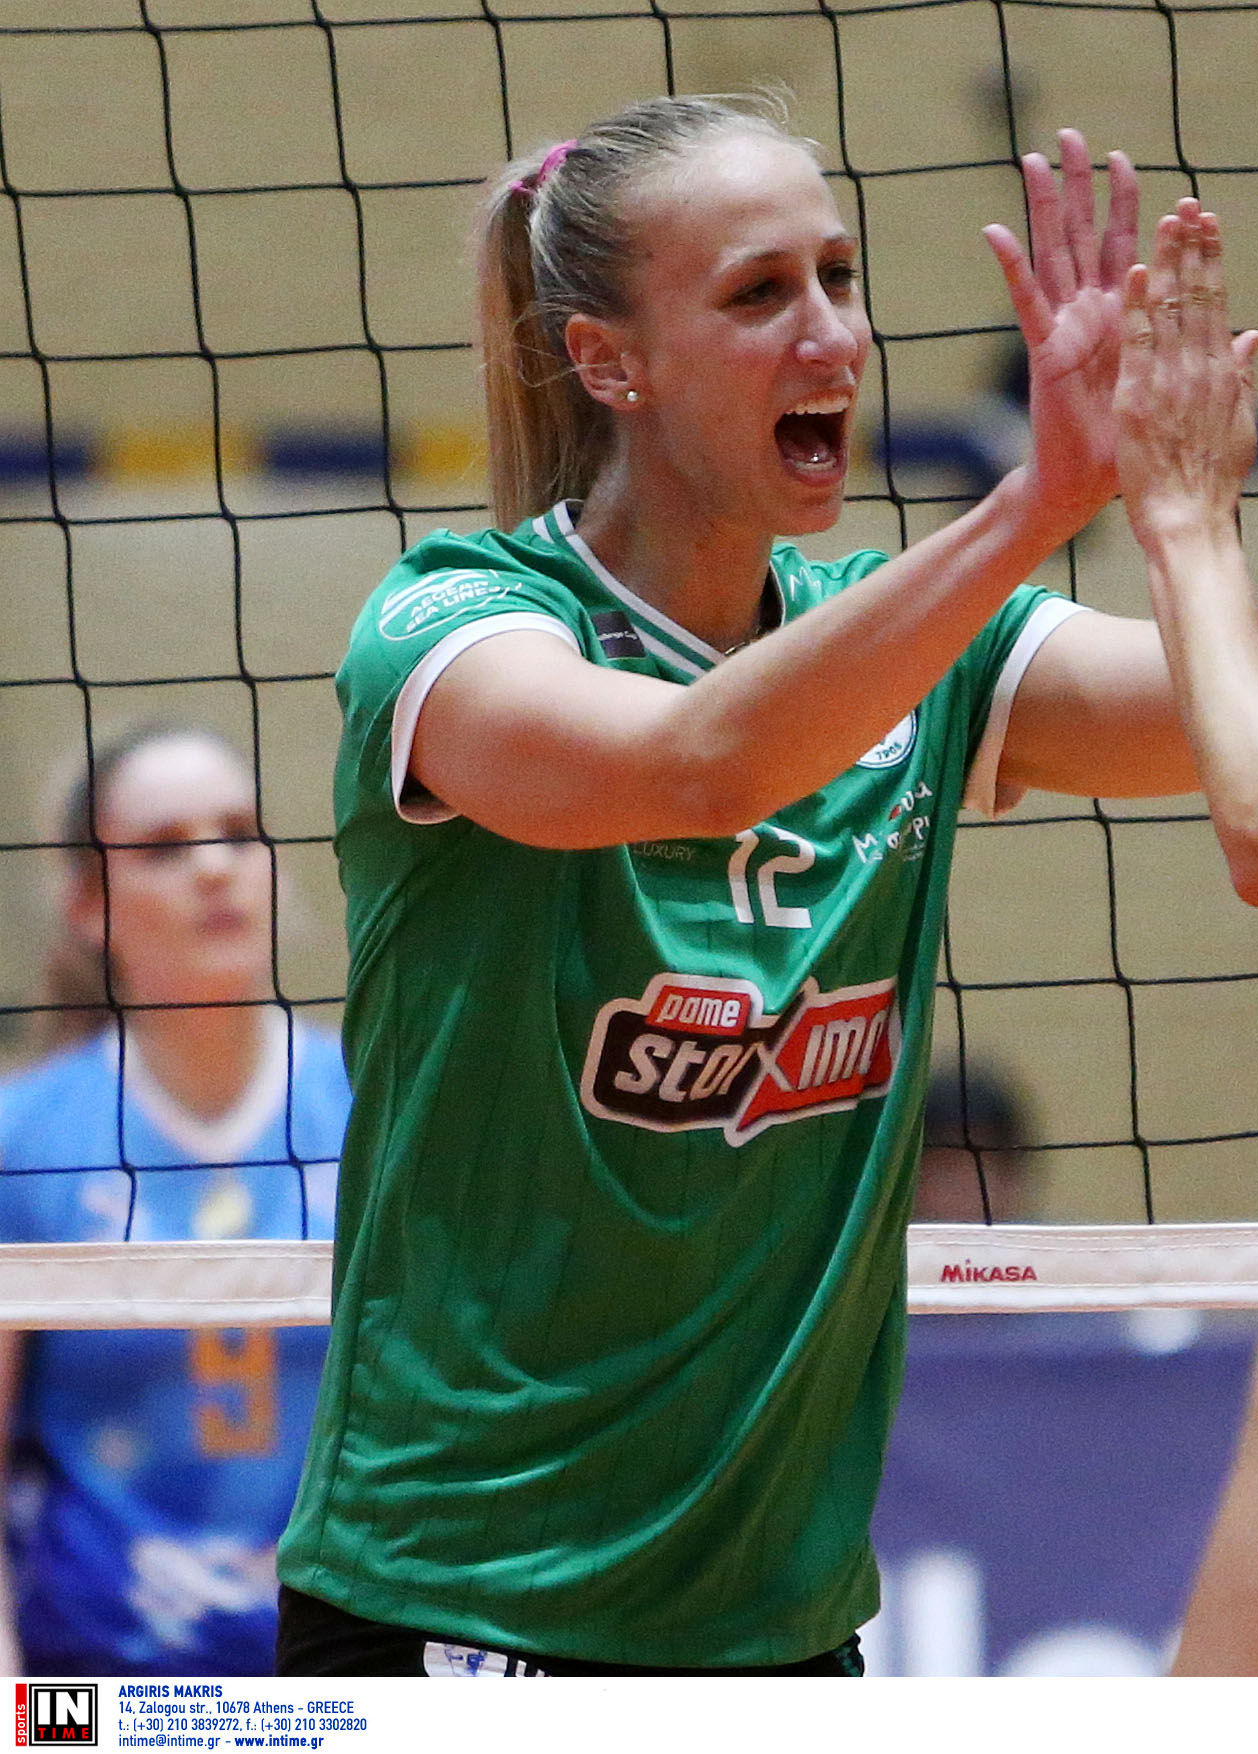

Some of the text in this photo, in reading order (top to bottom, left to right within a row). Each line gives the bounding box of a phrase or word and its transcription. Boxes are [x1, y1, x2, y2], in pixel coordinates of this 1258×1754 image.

[406, 606, 440, 633] SEA
[728, 823, 814, 930] 12
[656, 993, 742, 1029] pame
